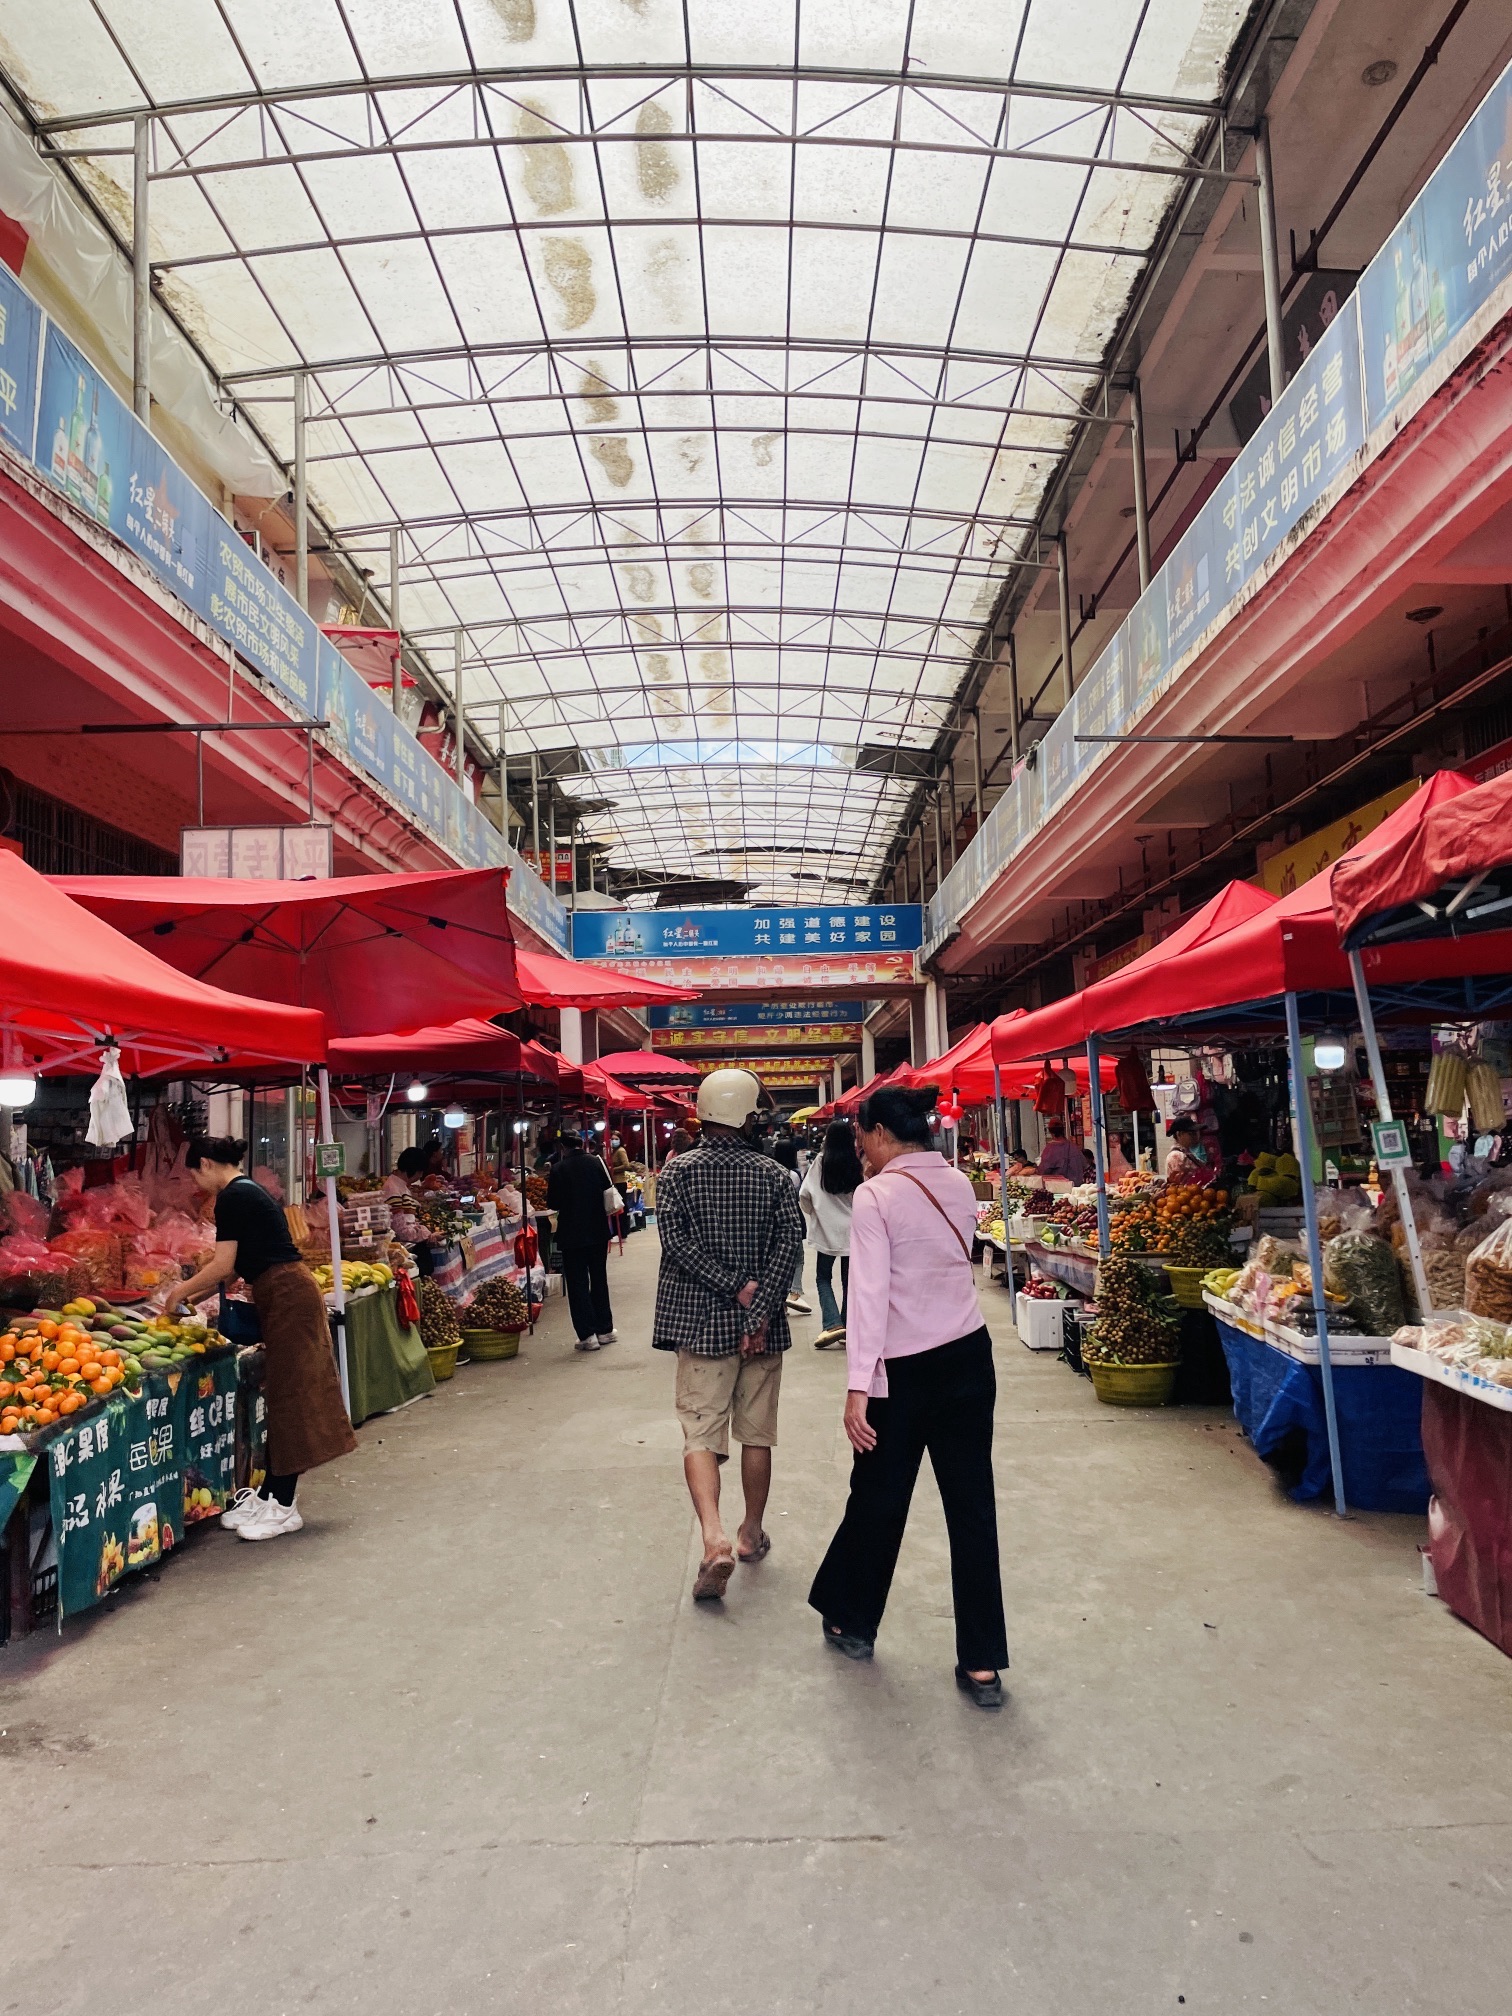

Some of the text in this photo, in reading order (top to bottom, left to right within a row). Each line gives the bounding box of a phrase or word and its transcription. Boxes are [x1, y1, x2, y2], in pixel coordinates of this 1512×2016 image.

[1223, 350, 1343, 530] 守法诚信经营
[1225, 406, 1347, 583] 共创文明市场
[219, 540, 305, 648] 农贸市场卫生整洁
[224, 575, 300, 669] 展市民文明风采
[210, 593, 308, 703] 彰农贸市场和谐品味
[754, 914, 896, 930] 加强道德建设
[754, 930, 897, 945] 共建美好家园
[669, 1026, 845, 1046] 诚实守信 文明经营
